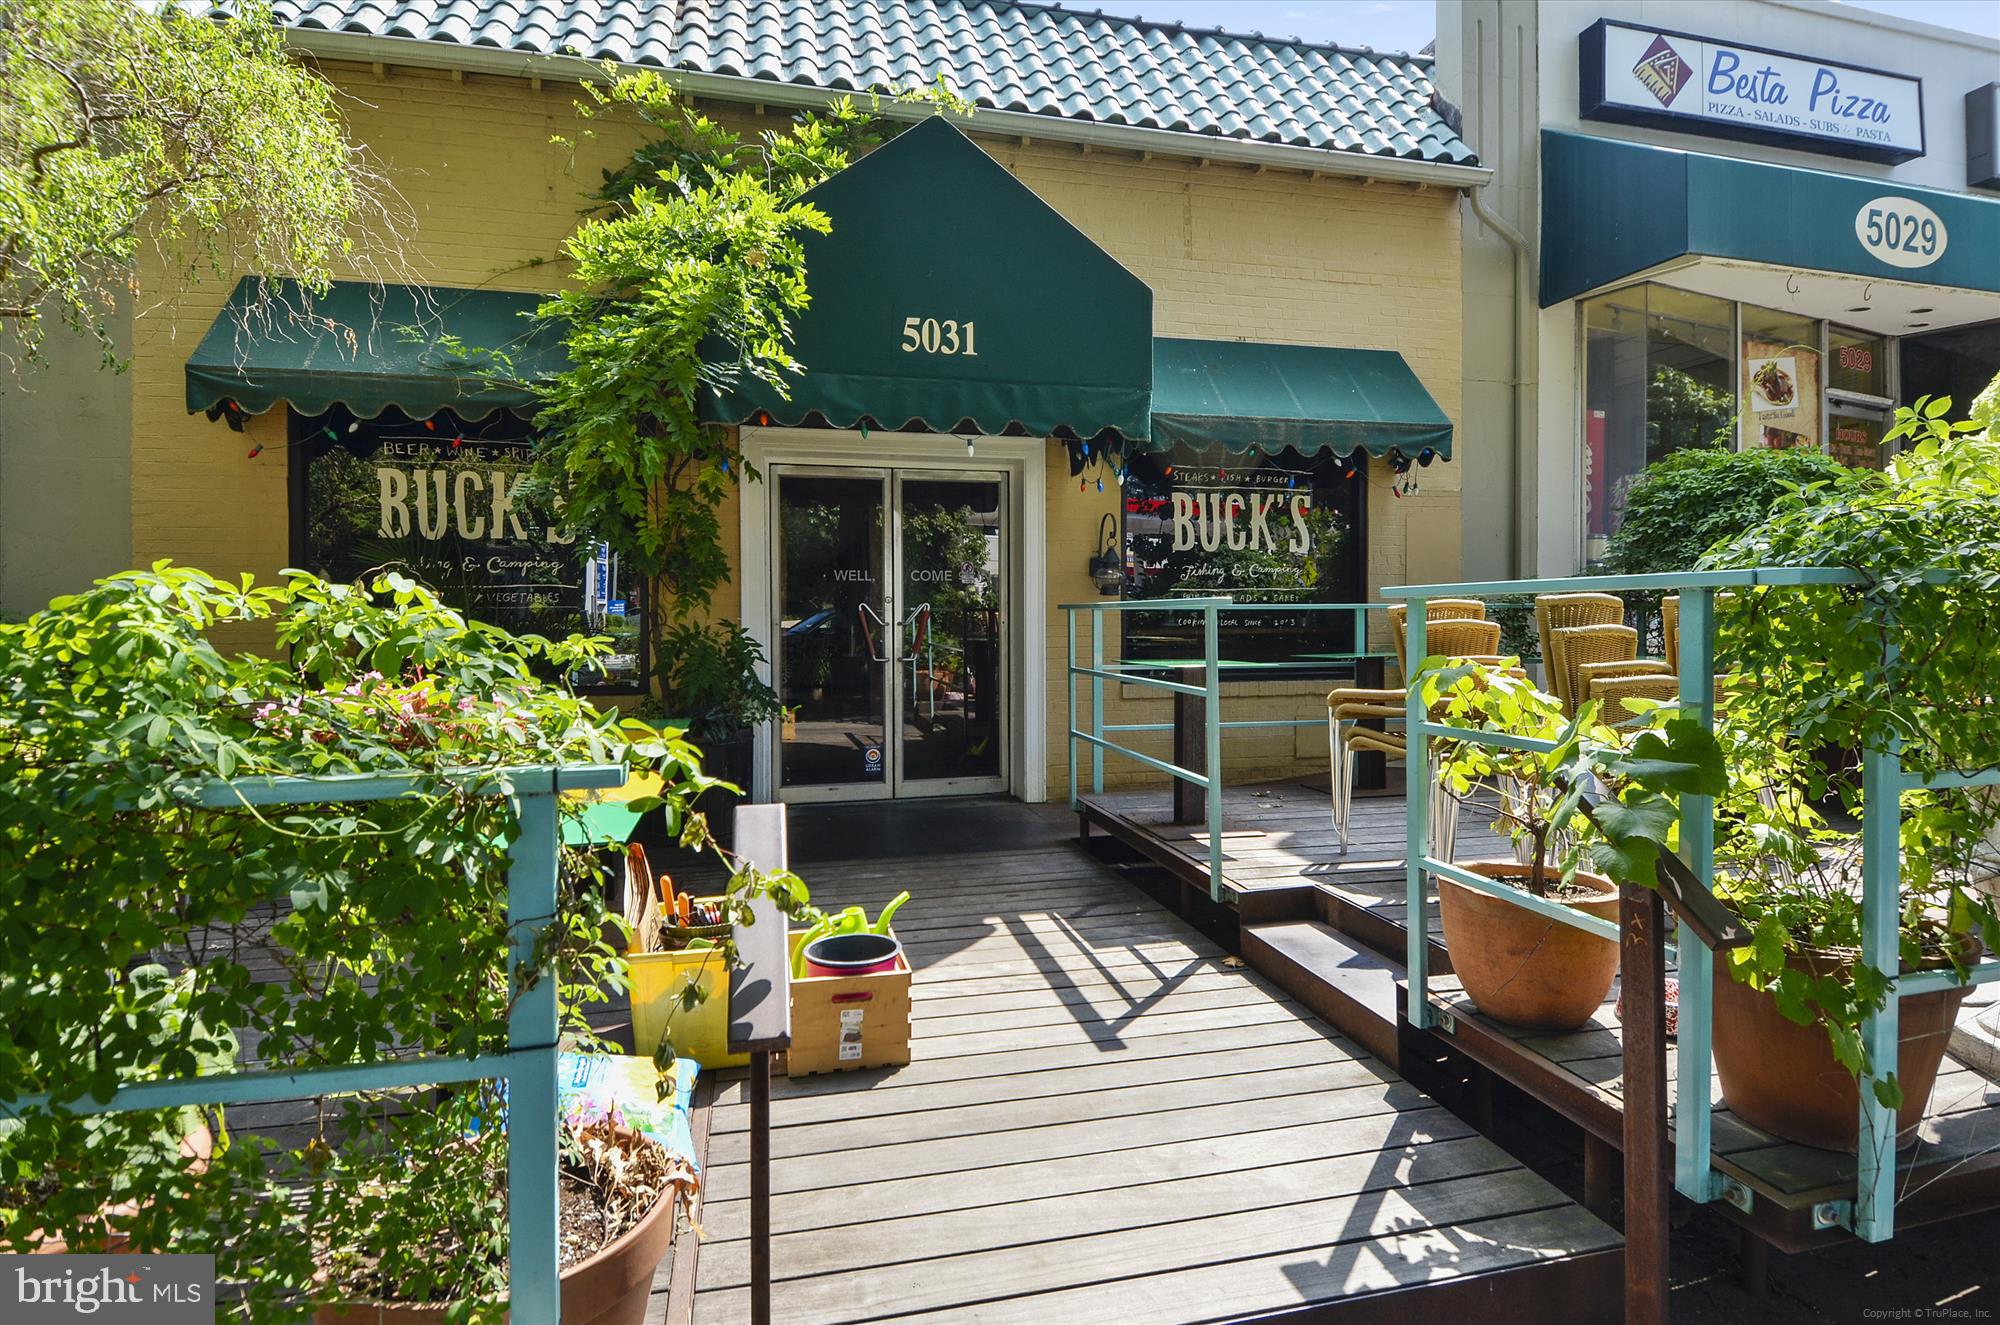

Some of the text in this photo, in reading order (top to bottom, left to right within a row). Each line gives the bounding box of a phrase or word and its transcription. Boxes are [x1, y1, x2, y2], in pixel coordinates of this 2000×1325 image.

[1707, 50, 1892, 124] Besta Pizza
[1708, 102, 1744, 118] PIZZA
[1754, 110, 1800, 127] SALADS
[1809, 119, 1840, 133] SUBS
[1856, 127, 1892, 142] PASTA
[1866, 209, 1938, 257] 5029
[902, 317, 978, 356] 5031
[1840, 345, 1872, 373] 5029
[383, 442, 430, 456] BEER
[446, 445, 487, 458] WINE
[1173, 470, 1209, 482] STEAKS
[1171, 492, 1311, 554] BUCK'S
[462, 556, 481, 572] &
[486, 555, 565, 577] Camping
[833, 569, 876, 584] WELL,
[910, 569, 953, 582] COME
[1180, 562, 1303, 584] Fishing & Camping
[486, 591, 560, 604] VEGETABLES
